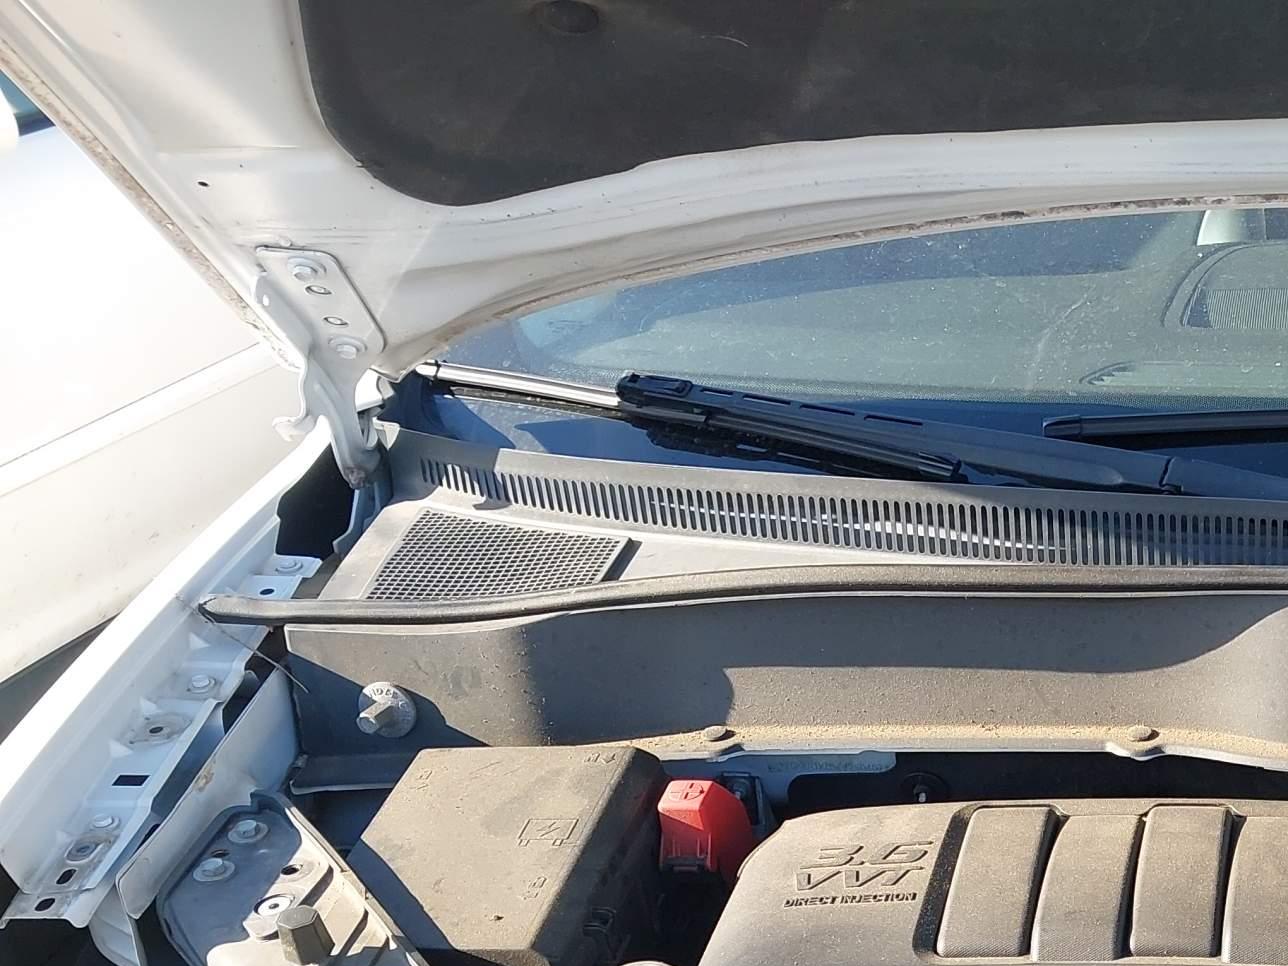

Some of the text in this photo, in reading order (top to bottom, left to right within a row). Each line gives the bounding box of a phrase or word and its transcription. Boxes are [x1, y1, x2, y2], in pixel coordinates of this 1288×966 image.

[799, 841, 935, 869] 3.6
[796, 866, 925, 891] VVT
[783, 892, 918, 908] DIRECT INJECTION
